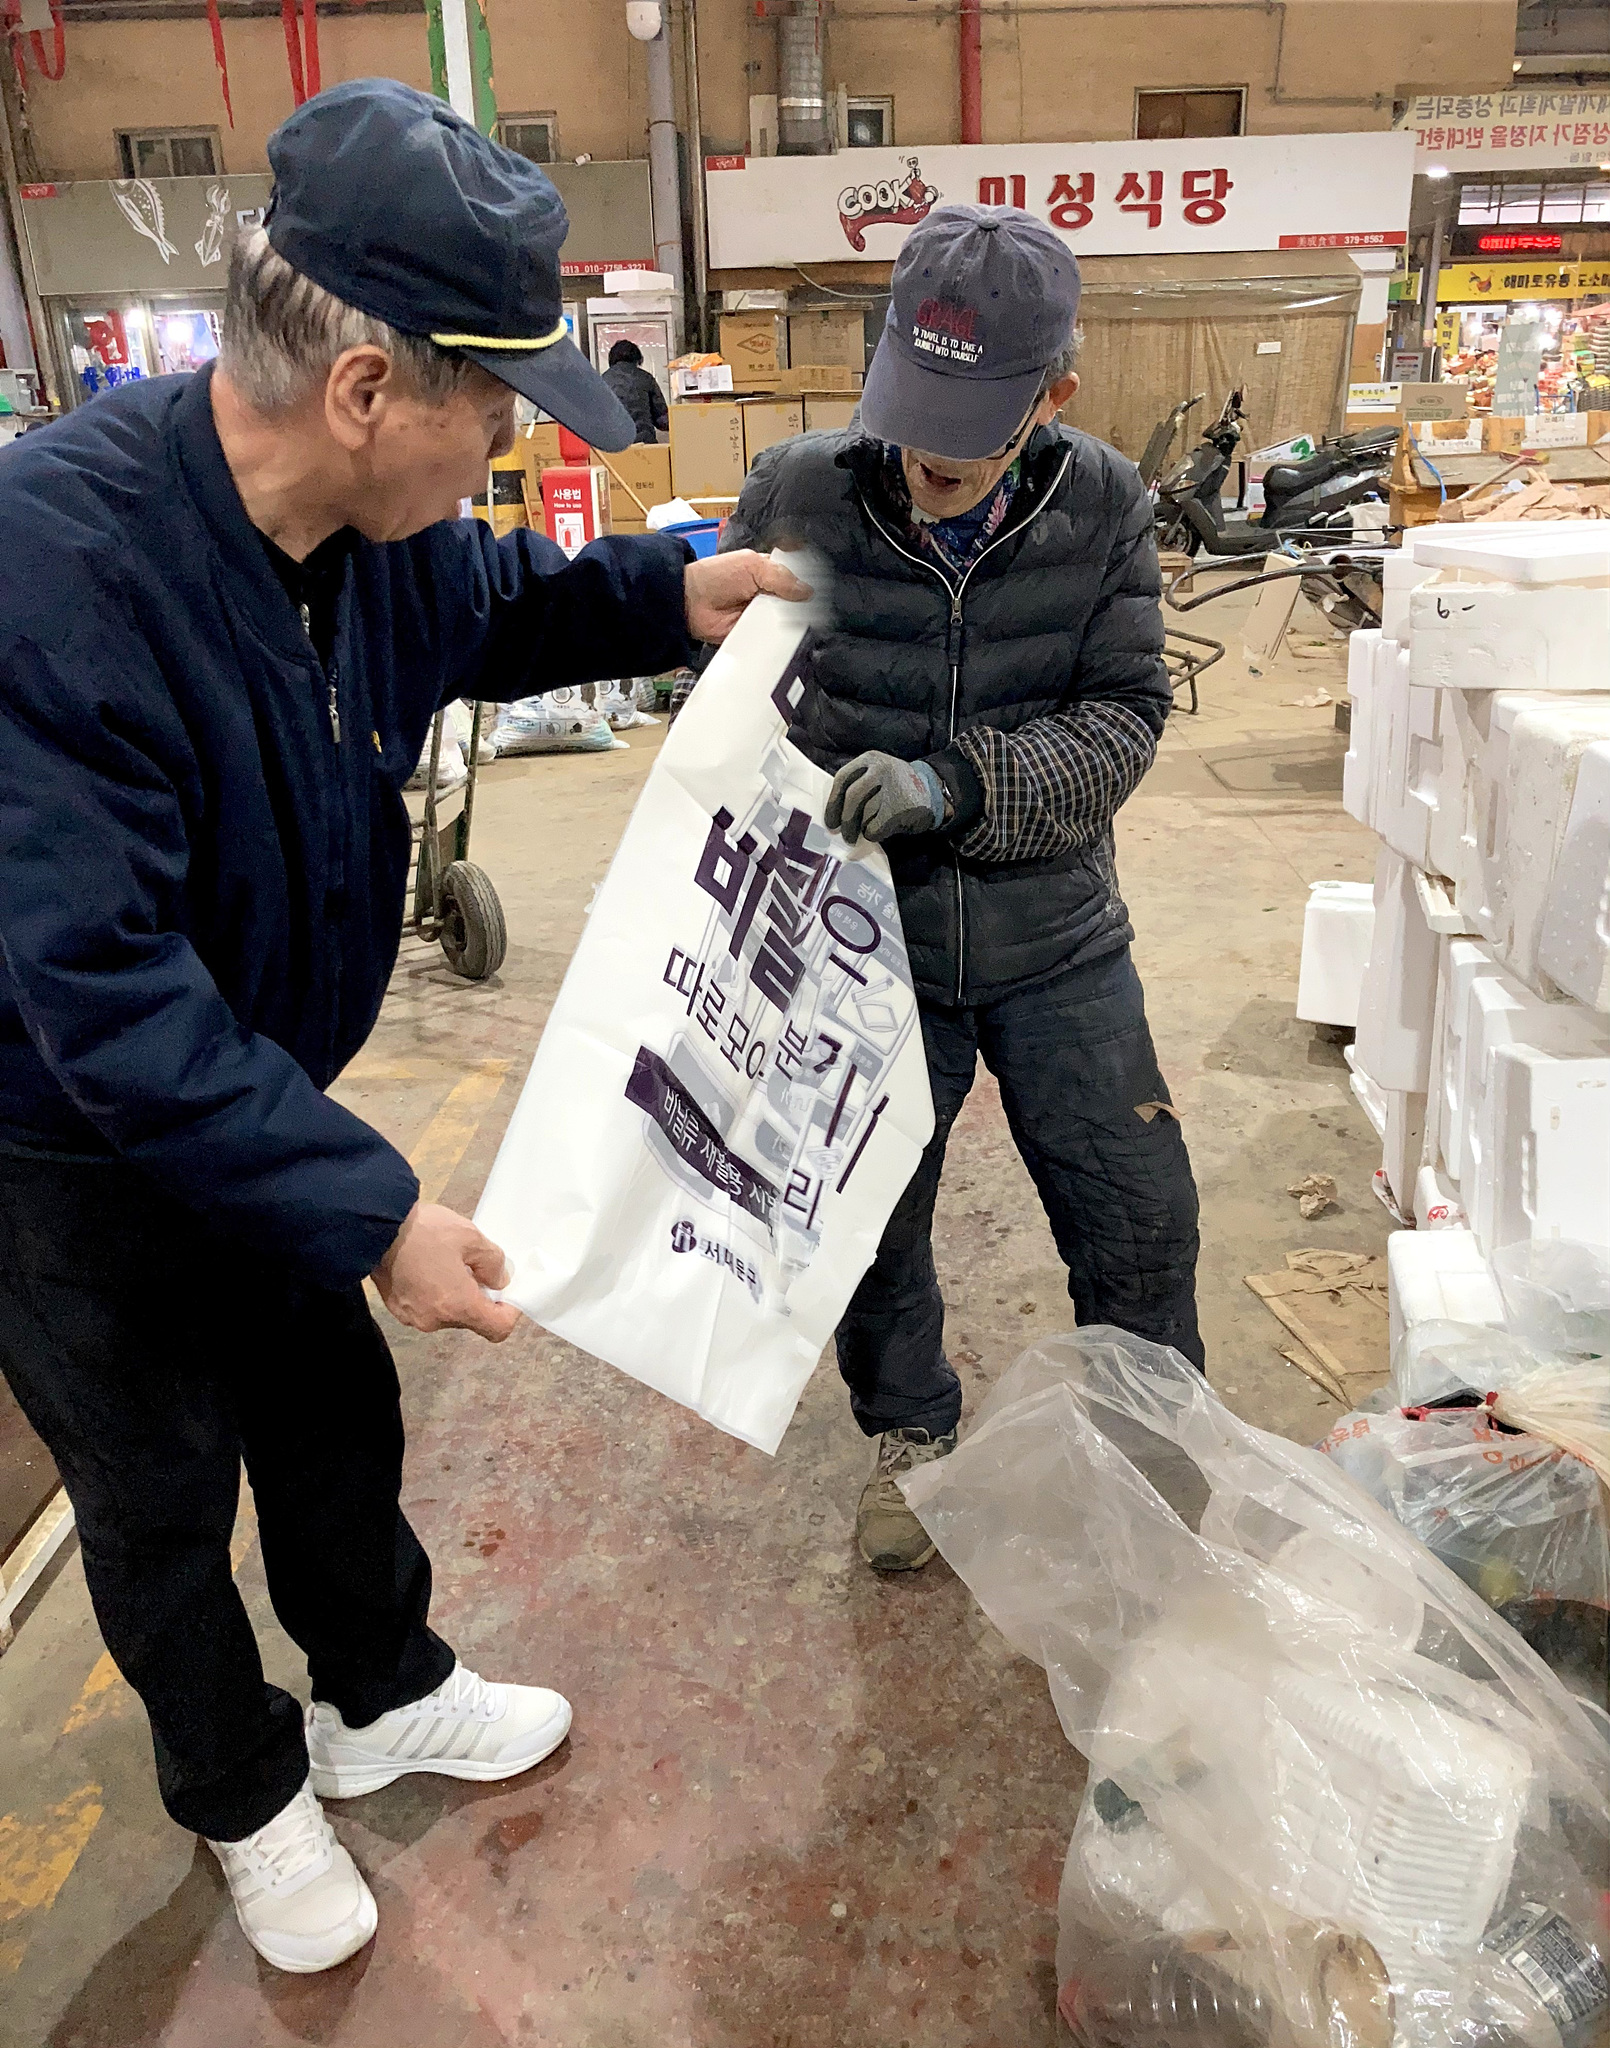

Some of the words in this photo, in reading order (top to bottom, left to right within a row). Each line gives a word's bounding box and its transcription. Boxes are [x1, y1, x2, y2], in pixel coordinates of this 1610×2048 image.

[978, 168, 1234, 230] 미성식당
[1344, 234, 1385, 245] 379-8562
[920, 329, 940, 344] TRAVEL
[941, 336, 948, 346] IS
[950, 338, 959, 349] TO
[961, 341, 977, 353] TAKE
[935, 345, 949, 357] INTO
[950, 350, 979, 363] YOURSELF
[552, 488, 582, 501] 사용법
